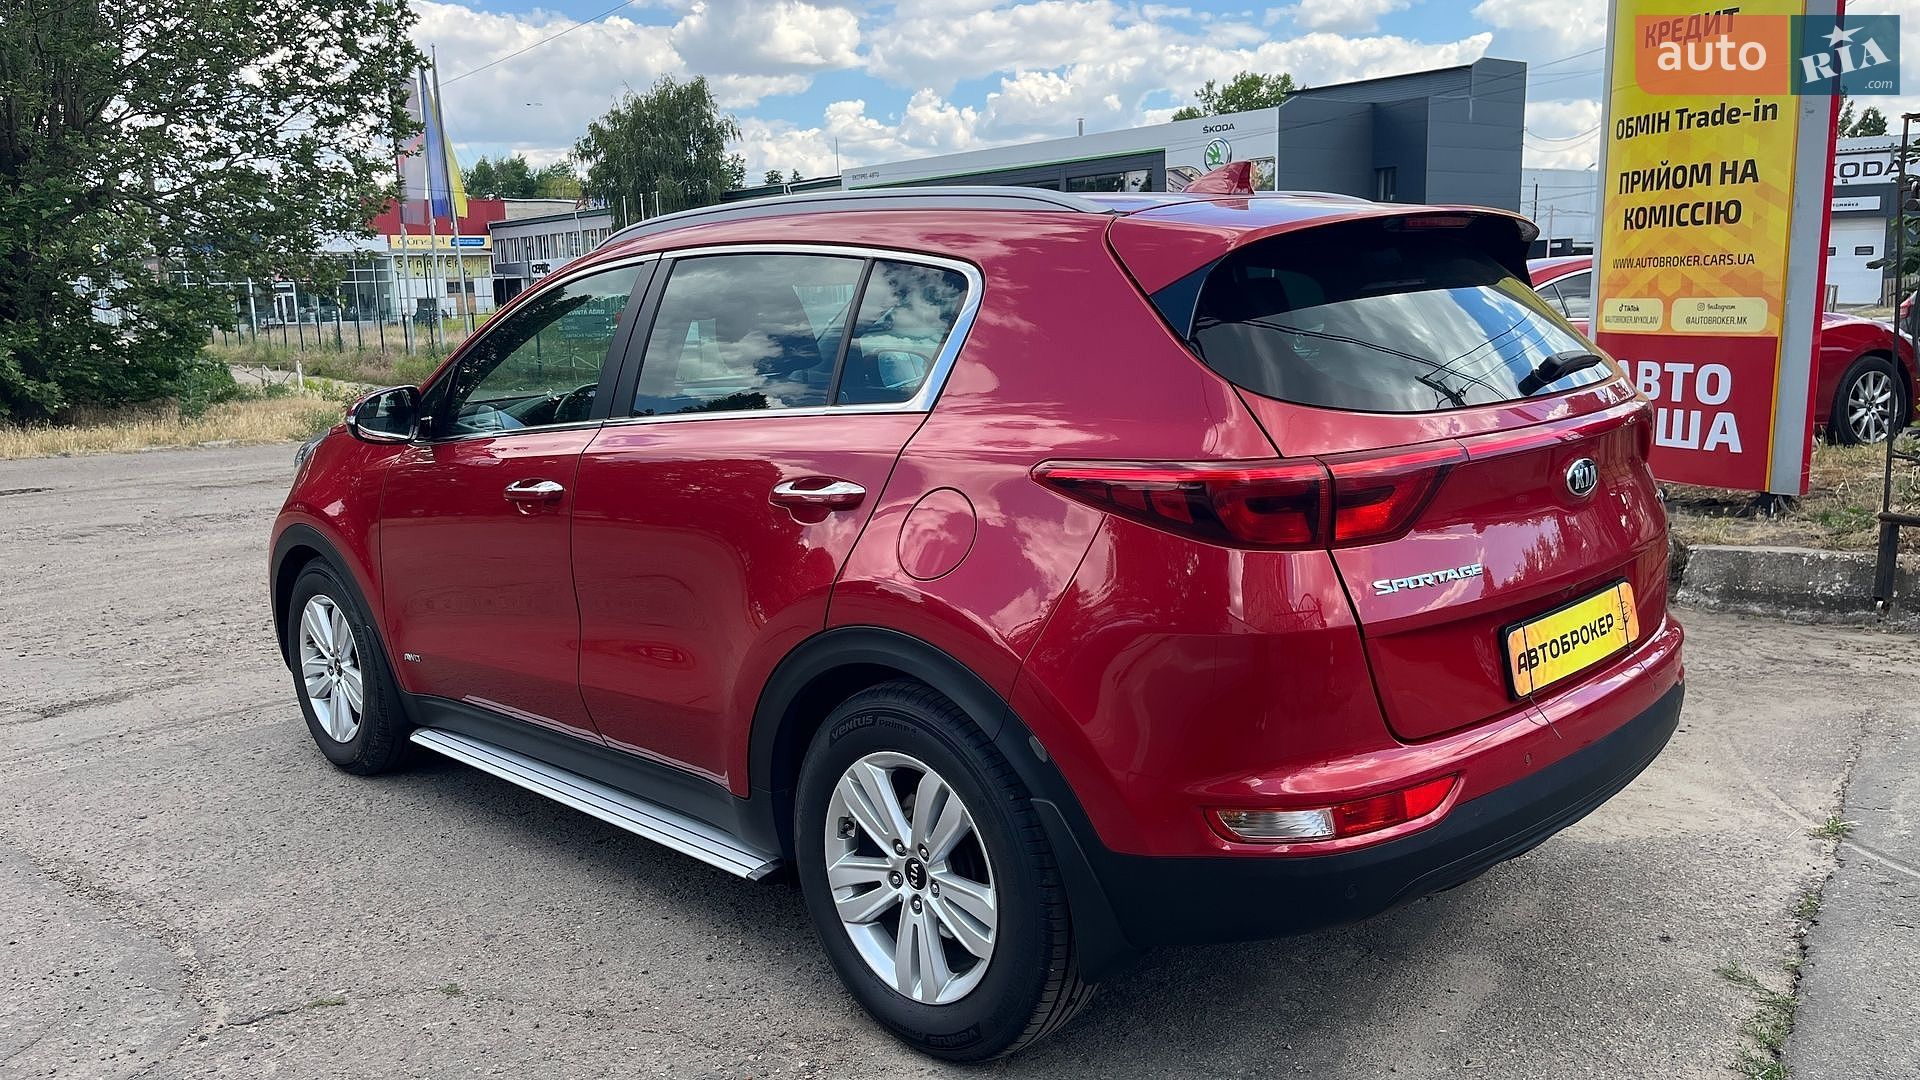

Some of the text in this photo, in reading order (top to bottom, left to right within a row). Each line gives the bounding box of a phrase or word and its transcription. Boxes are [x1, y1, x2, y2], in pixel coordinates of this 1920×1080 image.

[1644, 8, 1740, 48] КРЕДИТ
[1616, 98, 1779, 140] ОБМІН Trade-in
[1619, 158, 1759, 195] ПРИЙОМ НА
[1837, 159, 1902, 179] ODA
[1623, 199, 1743, 231] КОМІССІЮ
[1612, 253, 1755, 269] WWW.AUTOBROKER.CARS.UA
[1707, 303, 1736, 313] Instagram
[1655, 407, 1743, 454] ША
[1573, 465, 1597, 490] KIA
[1517, 613, 1614, 675] АВТОБРОКЕР
[910, 863, 919, 887] KIA
